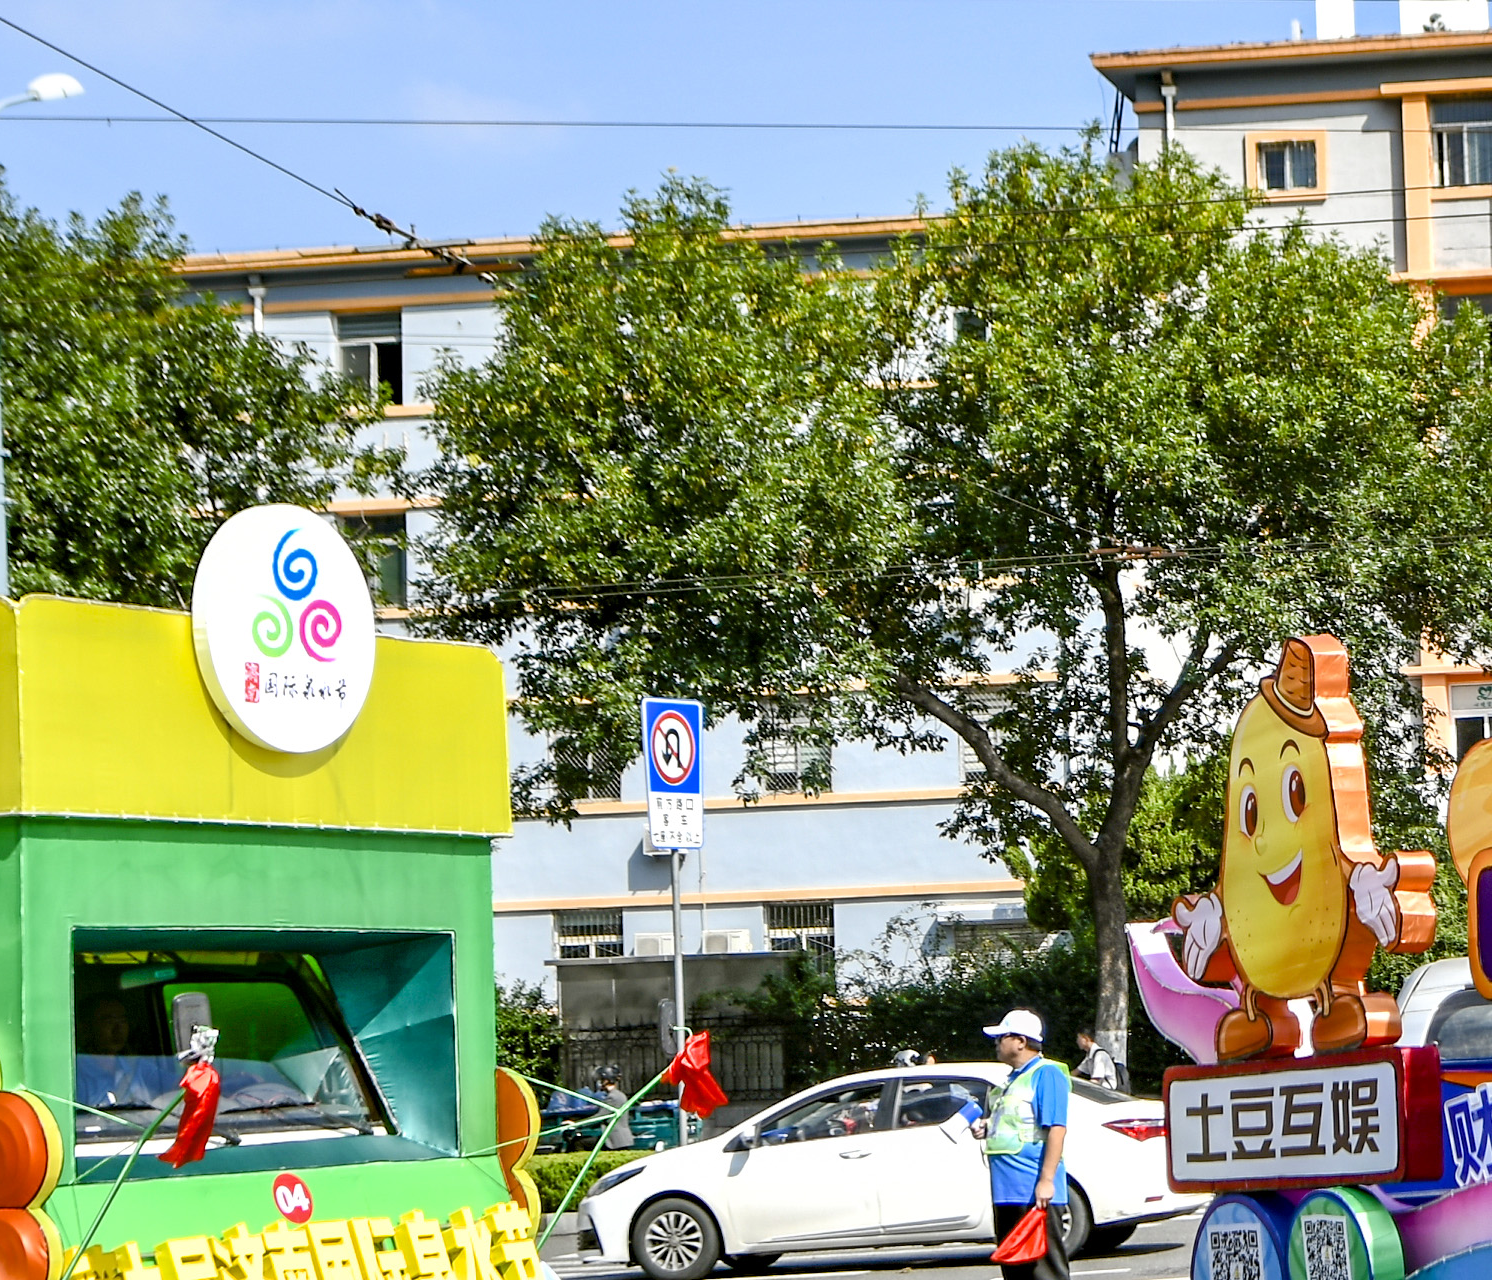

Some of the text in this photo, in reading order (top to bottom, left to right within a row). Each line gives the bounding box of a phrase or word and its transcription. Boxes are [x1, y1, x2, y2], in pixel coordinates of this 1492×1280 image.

[1186, 1077, 1380, 1163] 土豆互娱
[274, 1181, 310, 1214] 04
